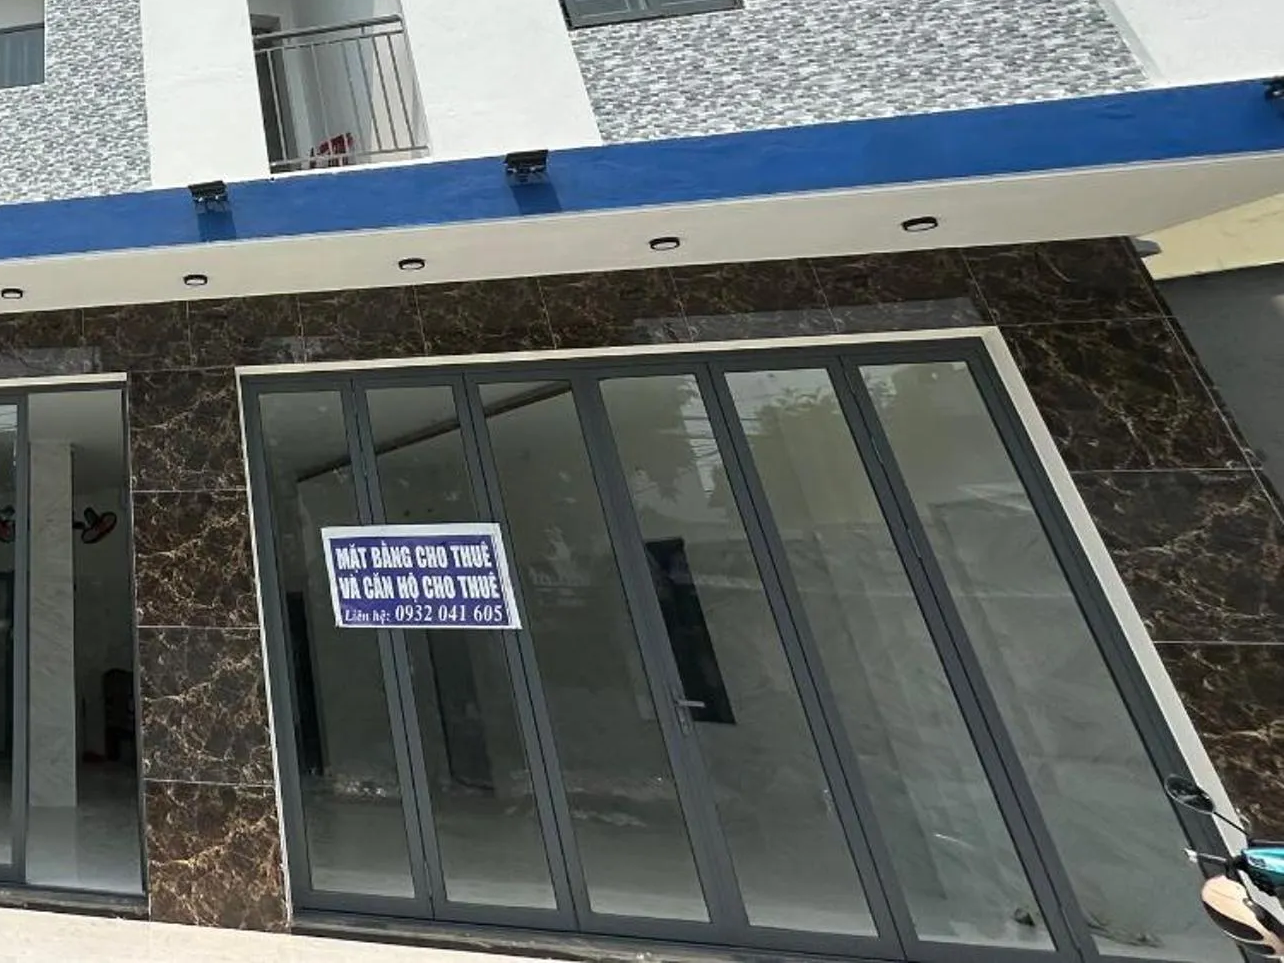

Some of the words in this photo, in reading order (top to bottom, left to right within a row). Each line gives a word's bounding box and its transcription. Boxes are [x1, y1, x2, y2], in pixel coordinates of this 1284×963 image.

[335, 543, 368, 574] MẶT
[371, 539, 413, 569] BẰNG
[414, 544, 449, 569] CHO
[450, 540, 493, 569] THUÊ
[338, 573, 362, 600] VÀ
[362, 571, 395, 599] CĂN
[397, 572, 420, 603] HỘ
[422, 575, 457, 600] CHO
[457, 571, 501, 600] THUÊ
[344, 608, 370, 623] Liên
[395, 604, 433, 622] 0932
[438, 604, 466, 622] 041
[473, 604, 503, 622] 605
